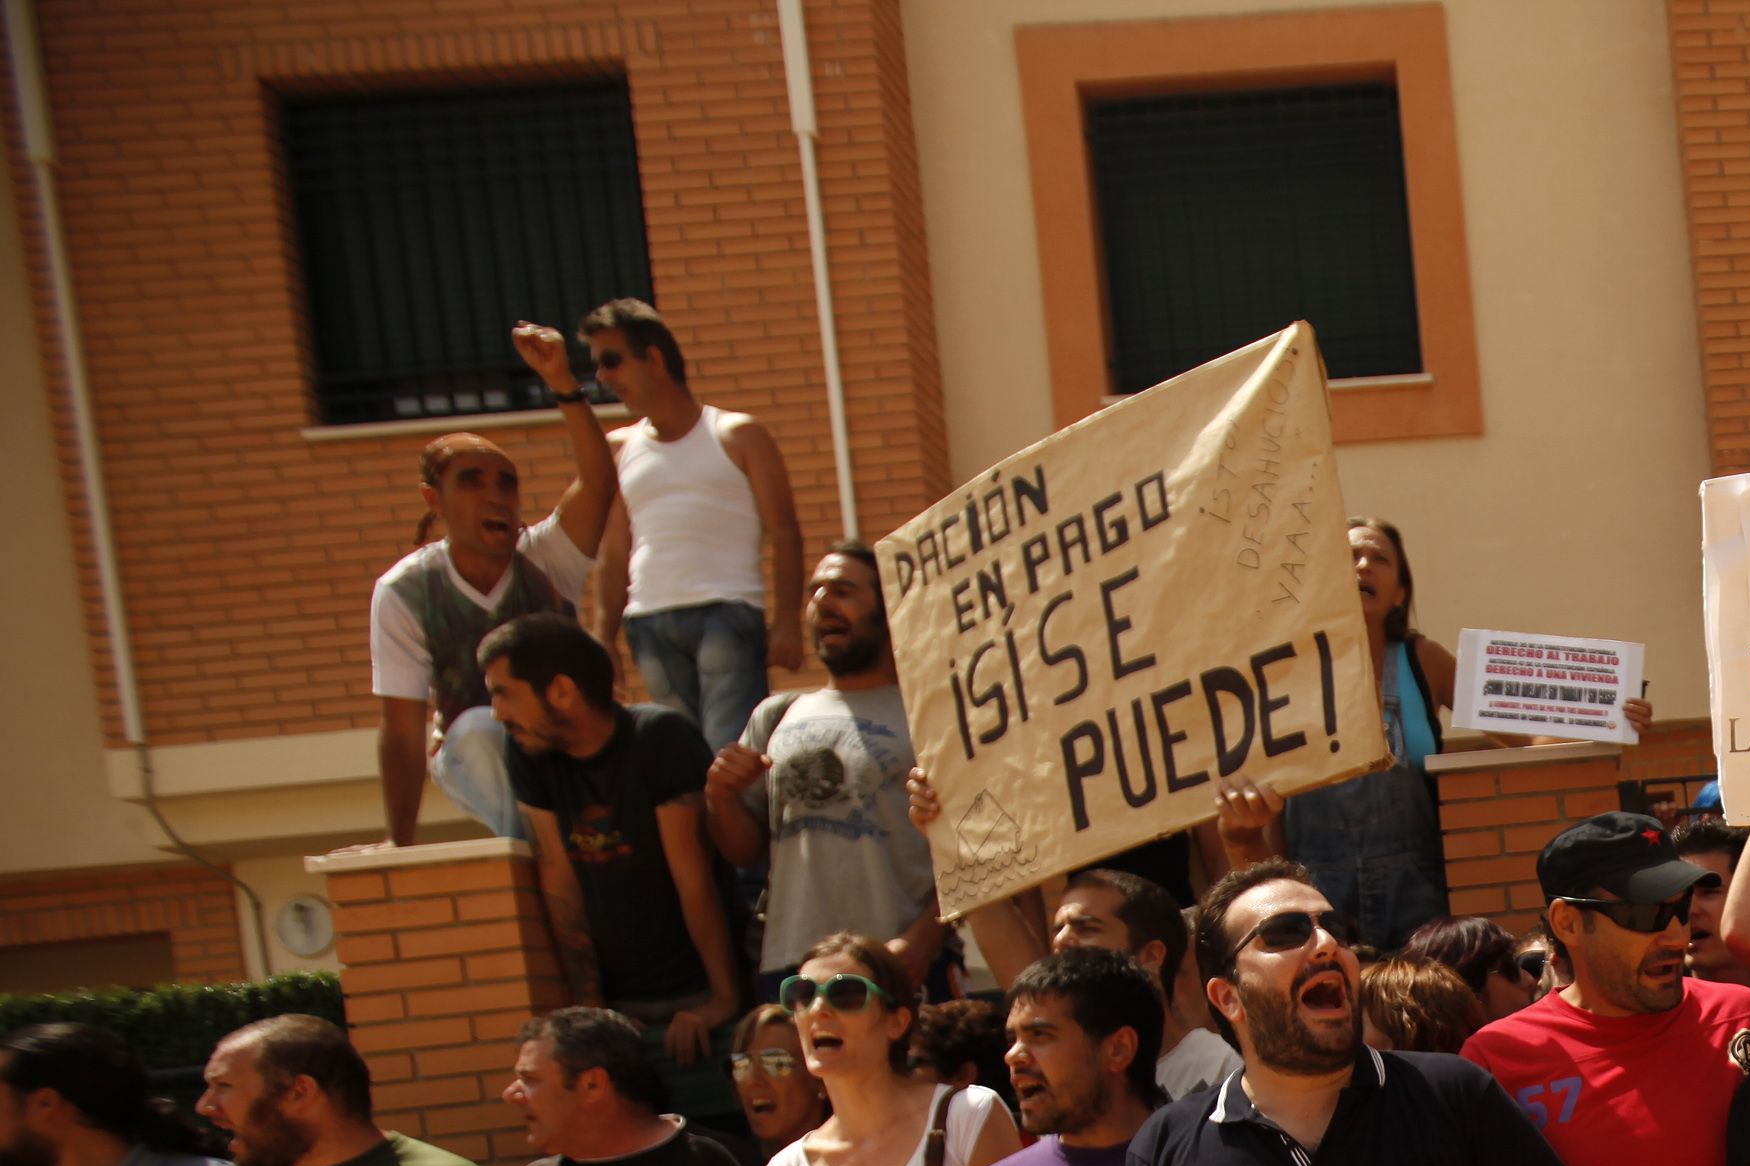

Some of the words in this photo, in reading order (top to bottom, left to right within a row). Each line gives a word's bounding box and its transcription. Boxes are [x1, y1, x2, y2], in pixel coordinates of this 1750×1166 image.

[951, 559, 1008, 634] EN
[1022, 470, 1170, 594] PAGO
[1038, 565, 1157, 706] SE
[1486, 645, 1543, 659] DERECHO
[1546, 650, 1560, 660] AL
[1565, 651, 1619, 666] TRABAJO
[1486, 663, 1534, 677] DERECHO
[1570, 671, 1619, 684] VIVIENDA
[1060, 630, 1341, 833] PUEDE!
